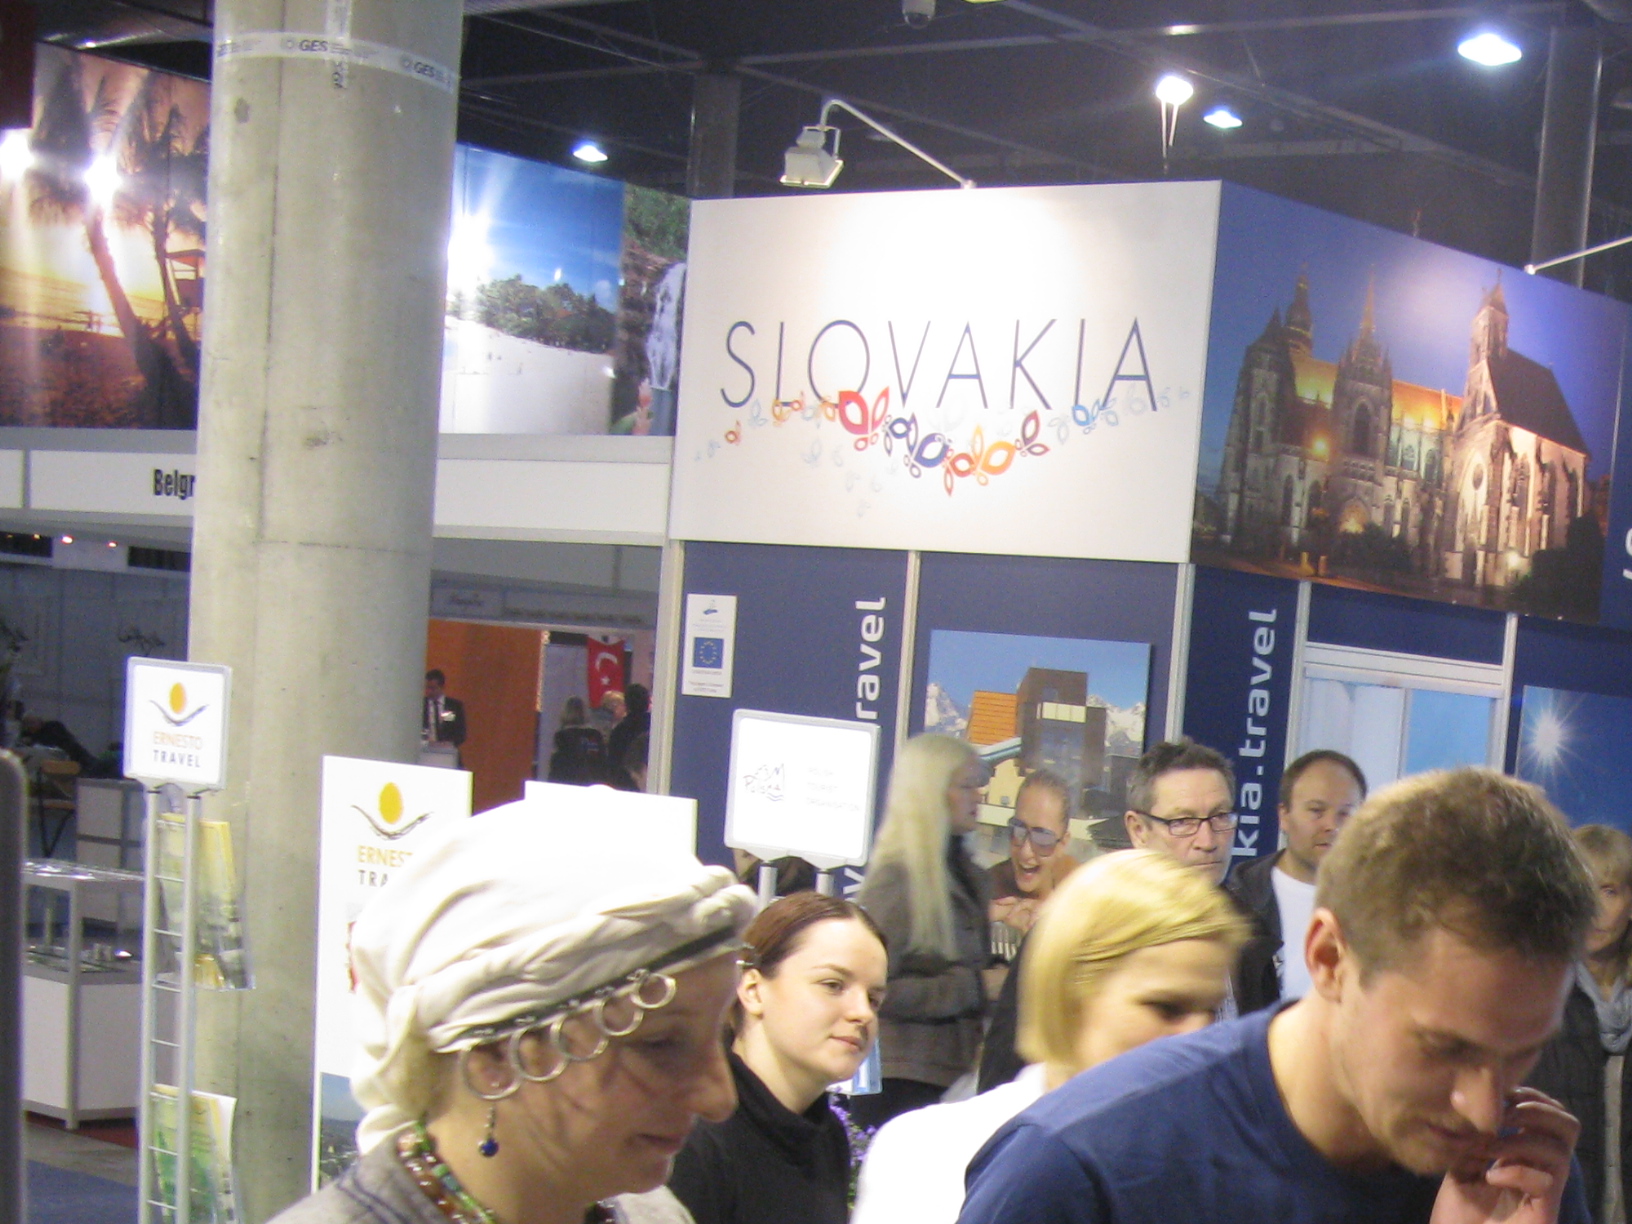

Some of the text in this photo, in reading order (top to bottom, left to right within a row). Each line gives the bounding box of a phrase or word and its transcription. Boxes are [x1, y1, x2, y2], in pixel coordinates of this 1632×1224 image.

[300, 39, 329, 52] GES
[720, 316, 1158, 412] SLOVAKIA
[153, 731, 203, 751] ERNESTO
[153, 749, 201, 768] TRAVEL
